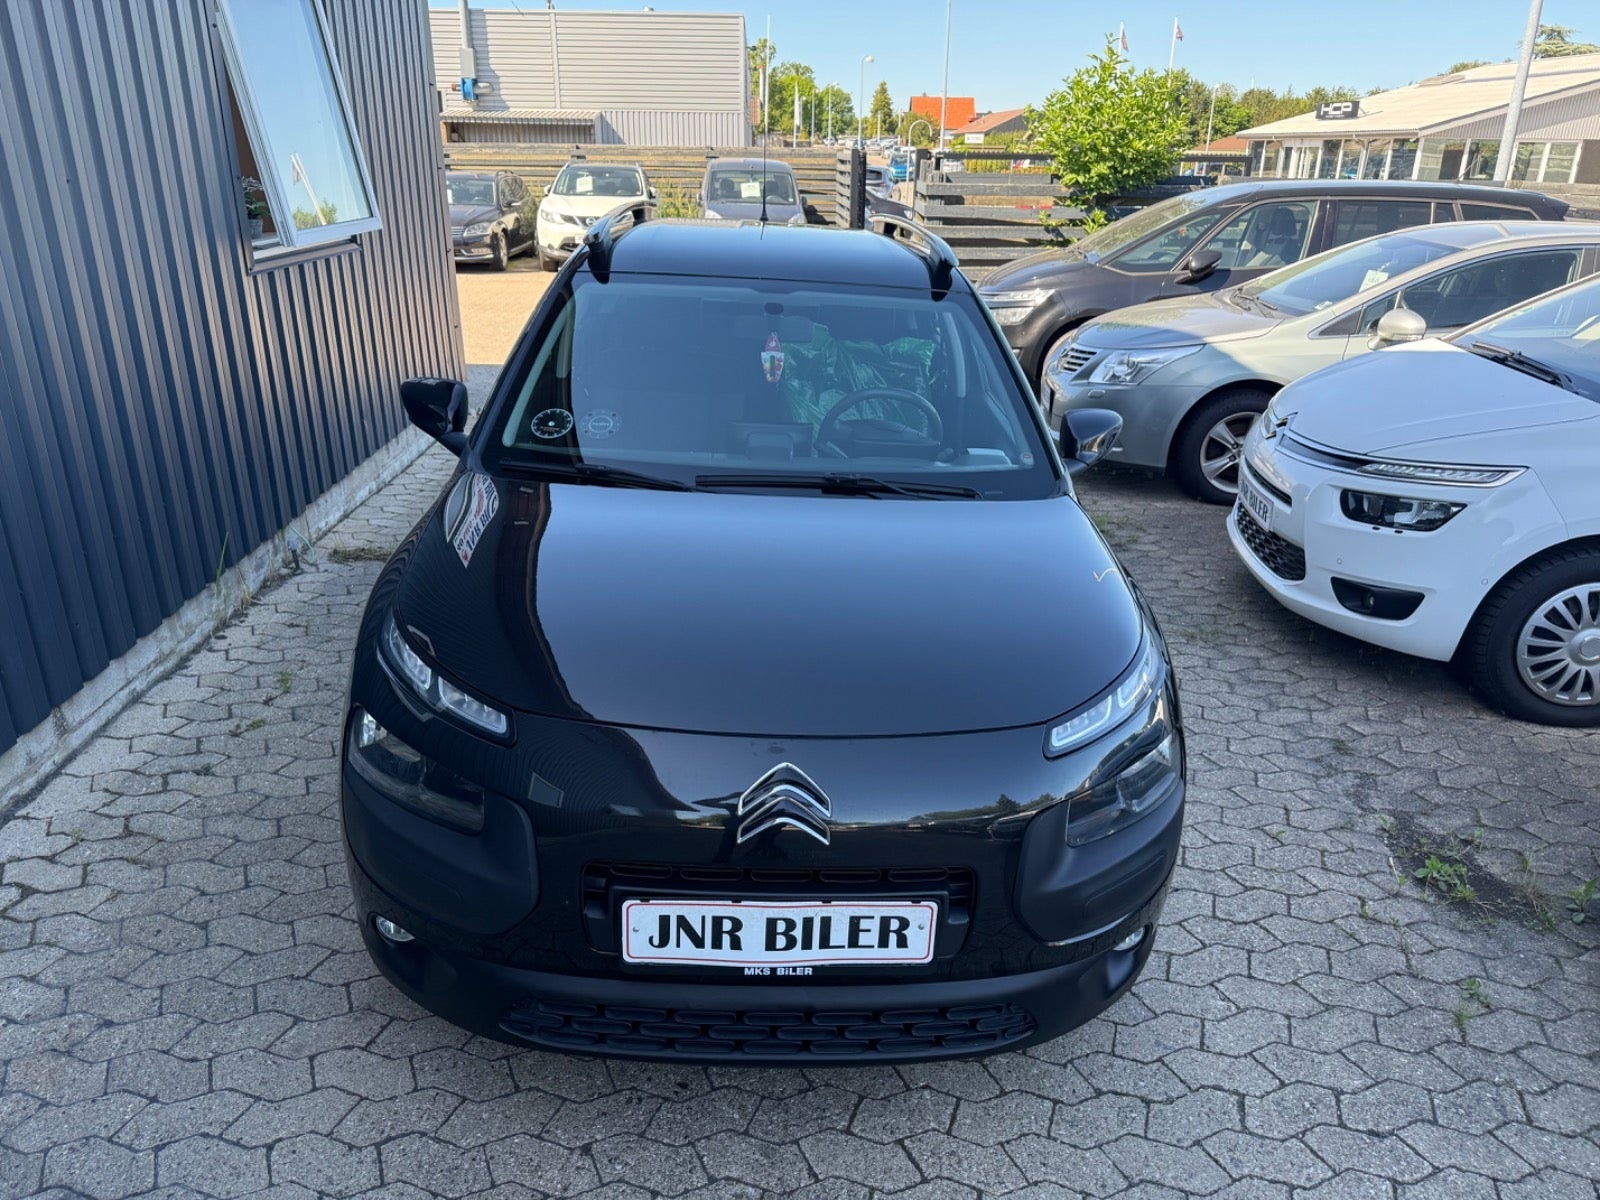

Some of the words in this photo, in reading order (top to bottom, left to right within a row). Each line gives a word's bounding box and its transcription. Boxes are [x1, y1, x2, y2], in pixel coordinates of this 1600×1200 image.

[1320, 102, 1352, 116] HCP
[1249, 490, 1268, 522] BILER
[648, 914, 743, 951] JNR
[764, 915, 911, 952] BILER
[744, 967, 771, 976] MKS
